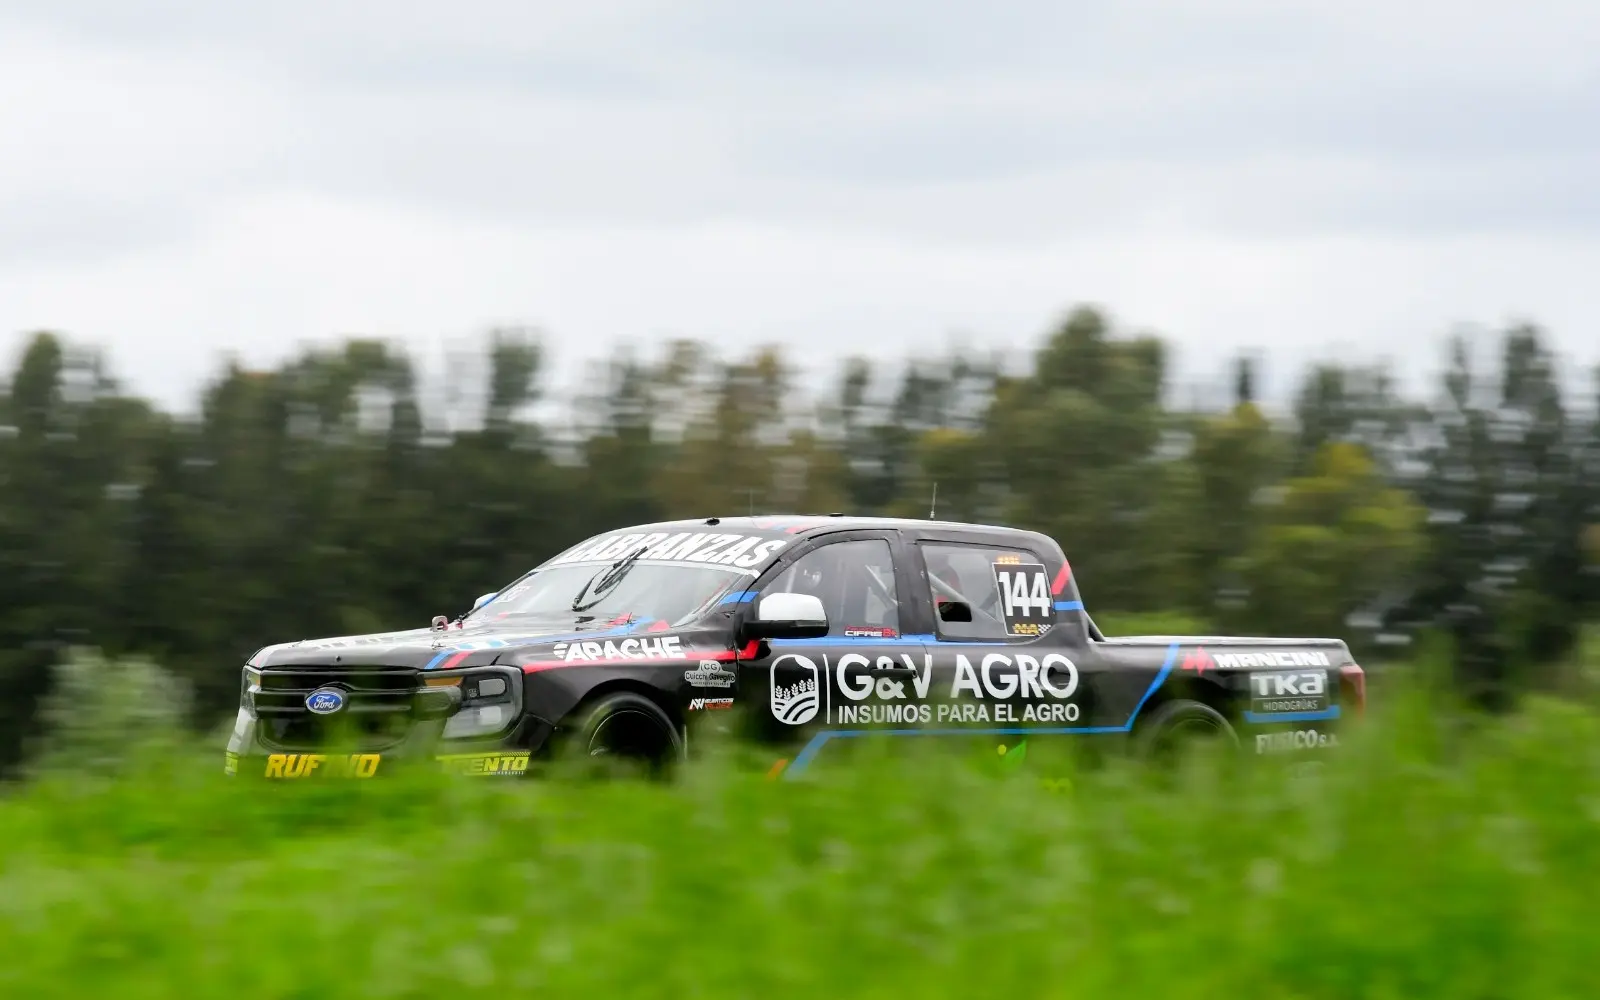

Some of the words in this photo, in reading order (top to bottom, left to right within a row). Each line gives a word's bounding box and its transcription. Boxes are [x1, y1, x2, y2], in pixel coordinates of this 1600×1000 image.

[999, 571, 1051, 617] 144
[565, 636, 686, 662] APACHE
[1212, 651, 1330, 668] MANCINI
[836, 653, 932, 700] G&V
[951, 653, 1079, 699] AGRO
[313, 695, 335, 709] Ford
[839, 705, 931, 724] INSUMOS
[937, 704, 990, 722] PARA
[995, 704, 1019, 721] EL
[1022, 703, 1080, 722] AGRO
[265, 753, 380, 778] RUFO
